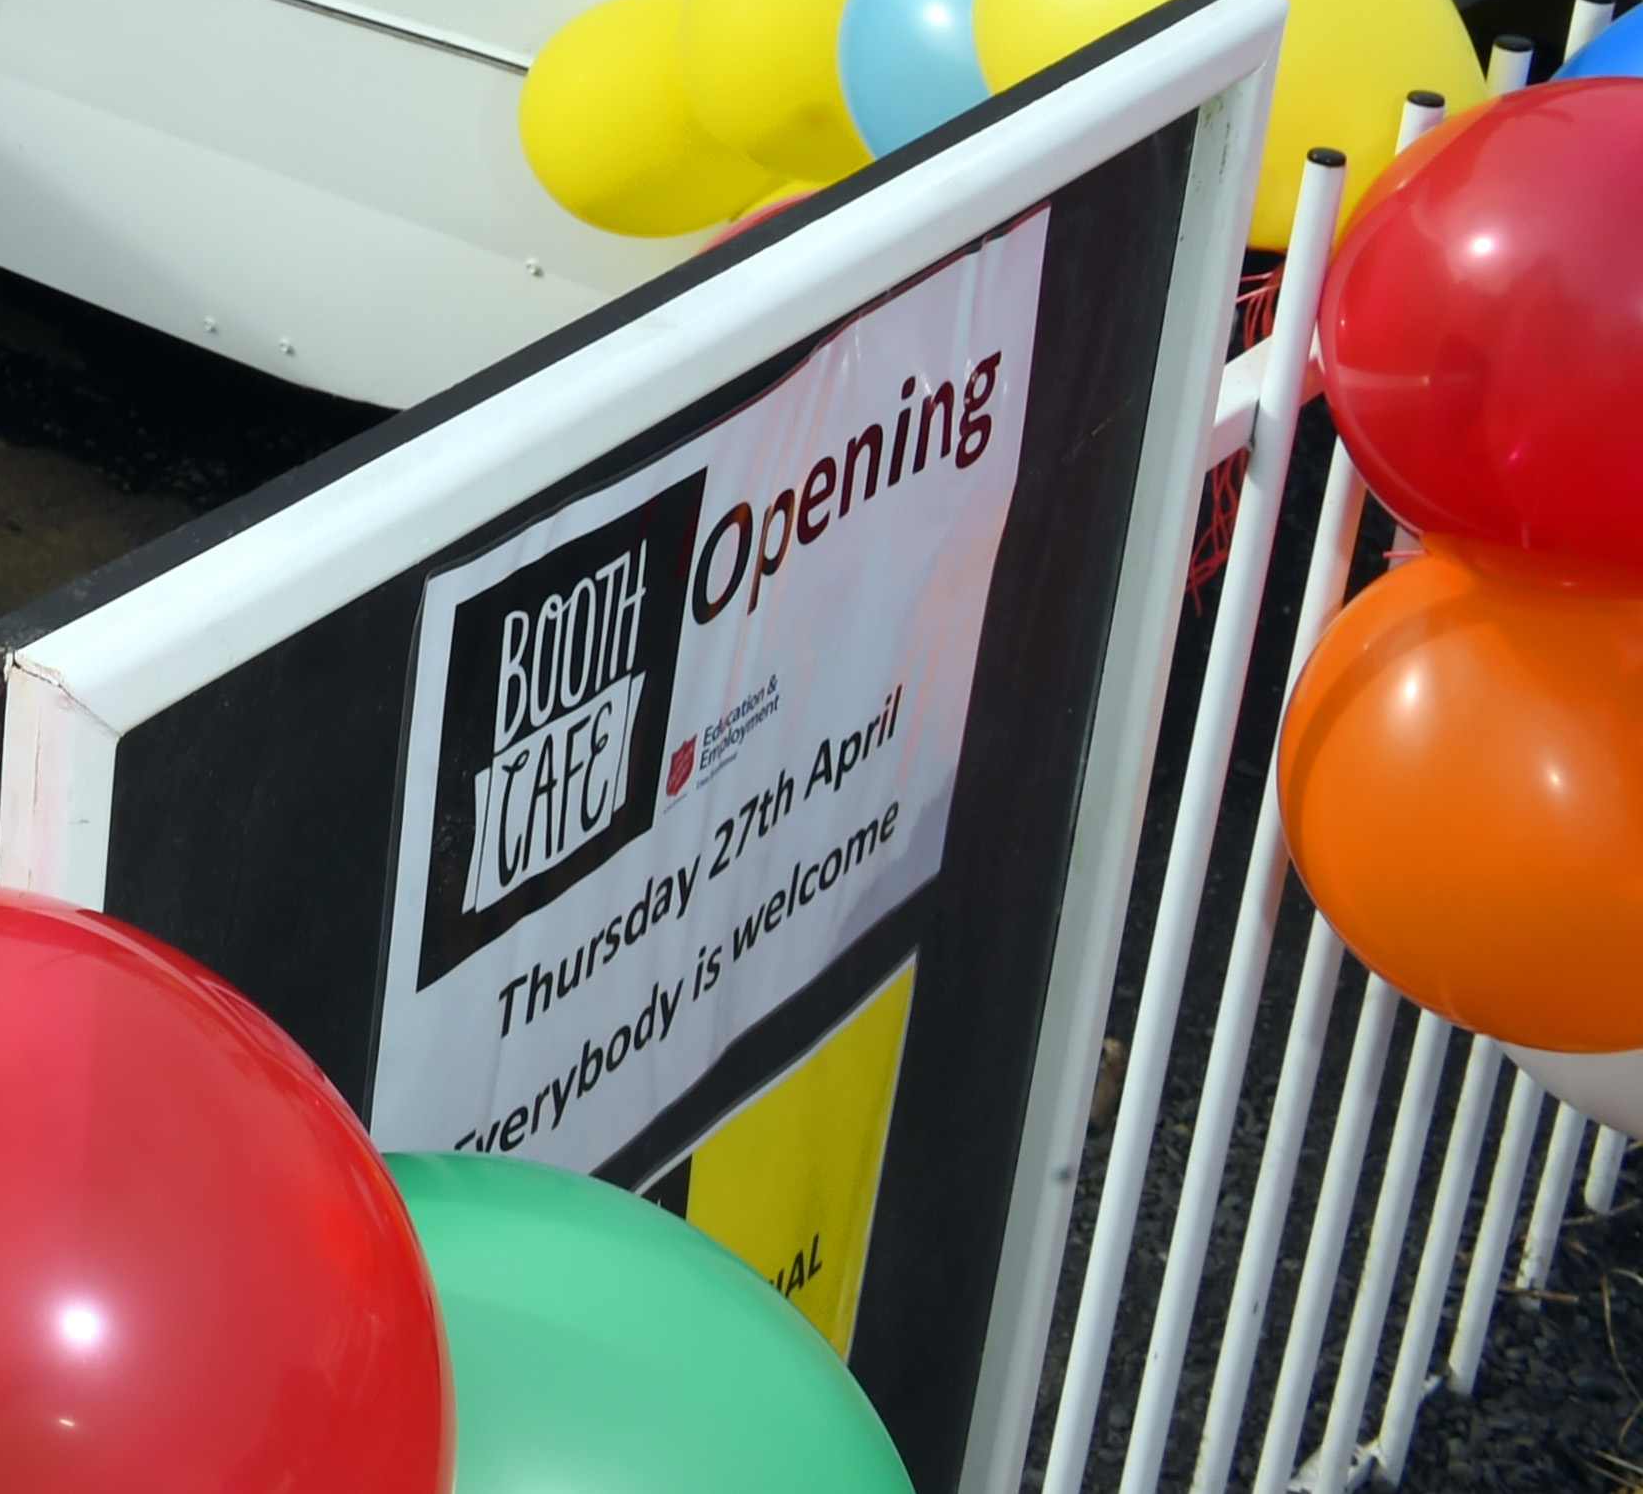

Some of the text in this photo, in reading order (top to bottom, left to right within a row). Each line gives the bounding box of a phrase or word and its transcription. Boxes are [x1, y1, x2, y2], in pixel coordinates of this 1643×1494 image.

[691, 350, 1003, 626] Opening
[493, 538, 647, 755] BOOTH
[699, 693, 781, 771] Employment
[702, 673, 778, 748] Education &
[498, 701, 613, 888] CAFE
[498, 683, 904, 1040] Thursday 27th April
[692, 944, 723, 1004] is
[731, 800, 901, 963] welcome
